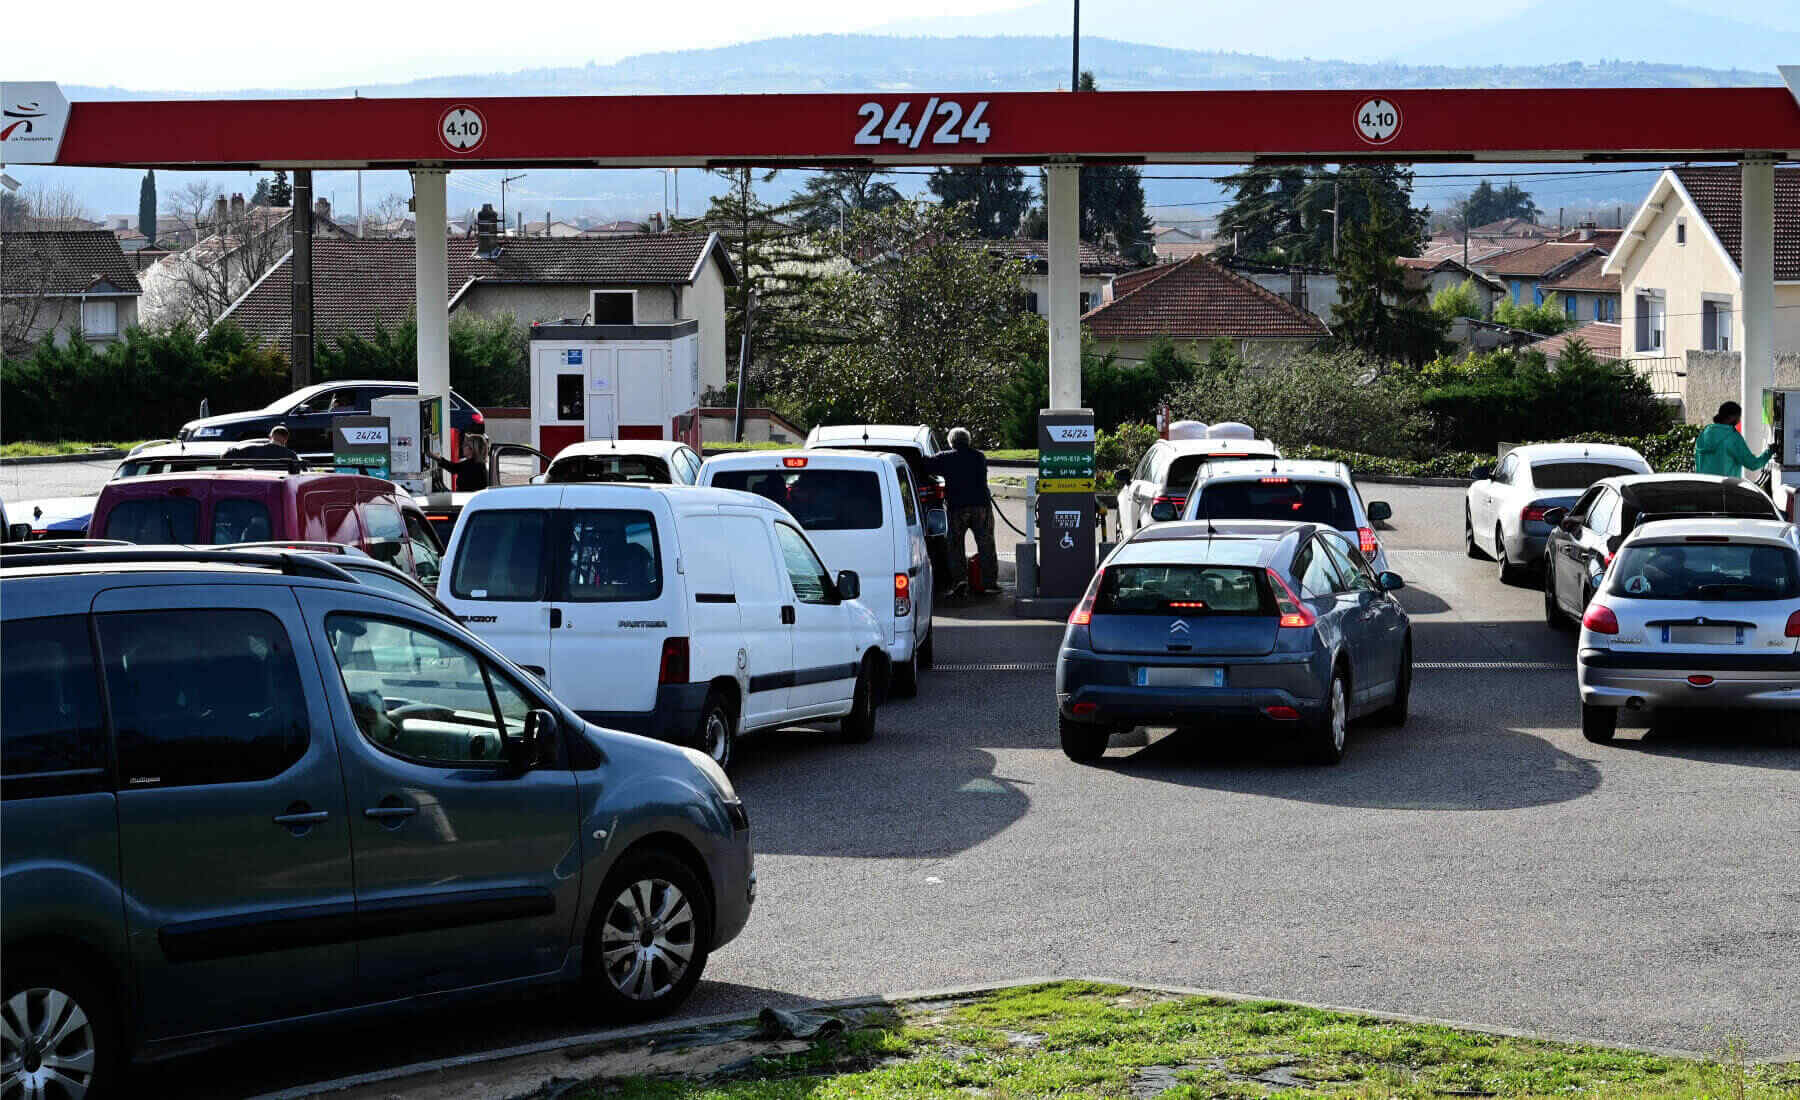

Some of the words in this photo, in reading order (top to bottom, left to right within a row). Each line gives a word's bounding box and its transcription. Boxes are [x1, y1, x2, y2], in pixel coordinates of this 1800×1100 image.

[854, 97, 991, 148] 24/24
[1361, 112, 1395, 127] 4.10
[446, 121, 479, 136] 4.10
[355, 431, 382, 440] 24/24
[1061, 429, 1088, 439] 24/24
